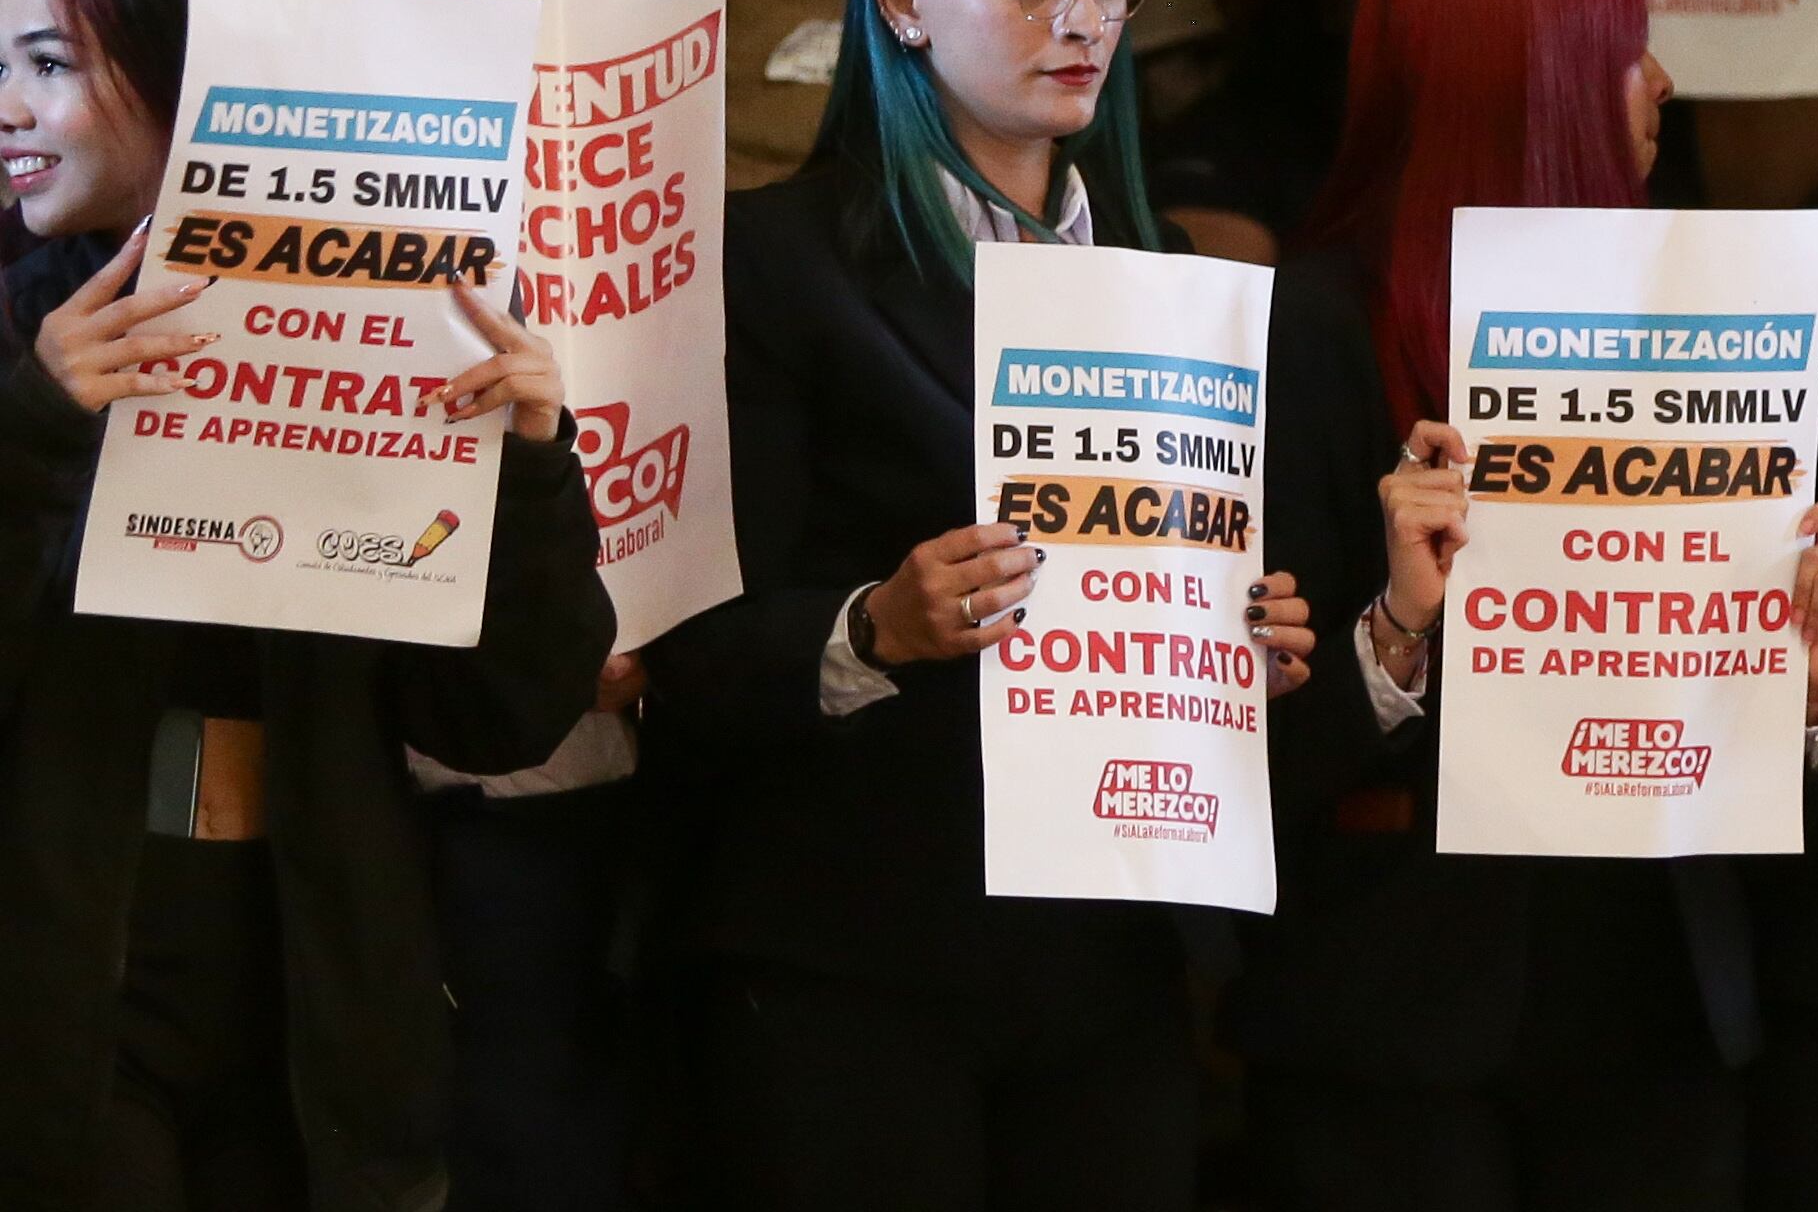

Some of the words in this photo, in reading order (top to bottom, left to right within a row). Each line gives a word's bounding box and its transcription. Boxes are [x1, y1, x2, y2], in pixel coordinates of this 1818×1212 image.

[208, 102, 503, 148] MONETIZACIÓN
[181, 161, 250, 197] DE
[266, 166, 336, 203] 1.5
[352, 171, 509, 213] SMMLV
[165, 217, 255, 268] ES
[256, 225, 496, 286] ACABAR
[245, 305, 346, 342] CON
[359, 315, 415, 347] EL
[1487, 323, 1802, 361] MONETIZACIÓN
[1007, 363, 1253, 414] MONETIZACIÓN
[1468, 386, 1537, 422] DE
[1559, 388, 1634, 423] 1.5
[1654, 388, 1806, 425] SMMLV
[134, 410, 188, 439] DE
[197, 416, 479, 465] APRENDIZAJE
[992, 423, 1054, 460] DE
[1074, 427, 1140, 464] 1.5
[1156, 429, 1256, 478] SMMLV
[1468, 444, 1555, 495] ES
[1562, 445, 1797, 498] ACABAR
[126, 513, 235, 539] SINDESENA
[999, 482, 1068, 534] ES
[1078, 484, 1249, 551] ACABAR
[1562, 530, 1665, 563] CON
[1682, 531, 1730, 562] EL
[1080, 569, 1172, 604] CON
[1183, 574, 1211, 610] EL
[1464, 587, 1791, 635] CONTRATO
[998, 628, 1254, 689] CONTRATO
[1471, 647, 1525, 674] DE
[1539, 647, 1787, 678] APRENDIZAJE
[1007, 687, 1056, 716] DE
[1069, 690, 1258, 733] APRENDIZAJE
[1573, 722, 1630, 748] ¡ME
[1638, 723, 1677, 749] LO
[1103, 763, 1152, 790] ¡ME
[1158, 765, 1188, 792] LO
[1571, 748, 1708, 775] MEREZCO!
[1101, 790, 1216, 823] MEREZCO!
